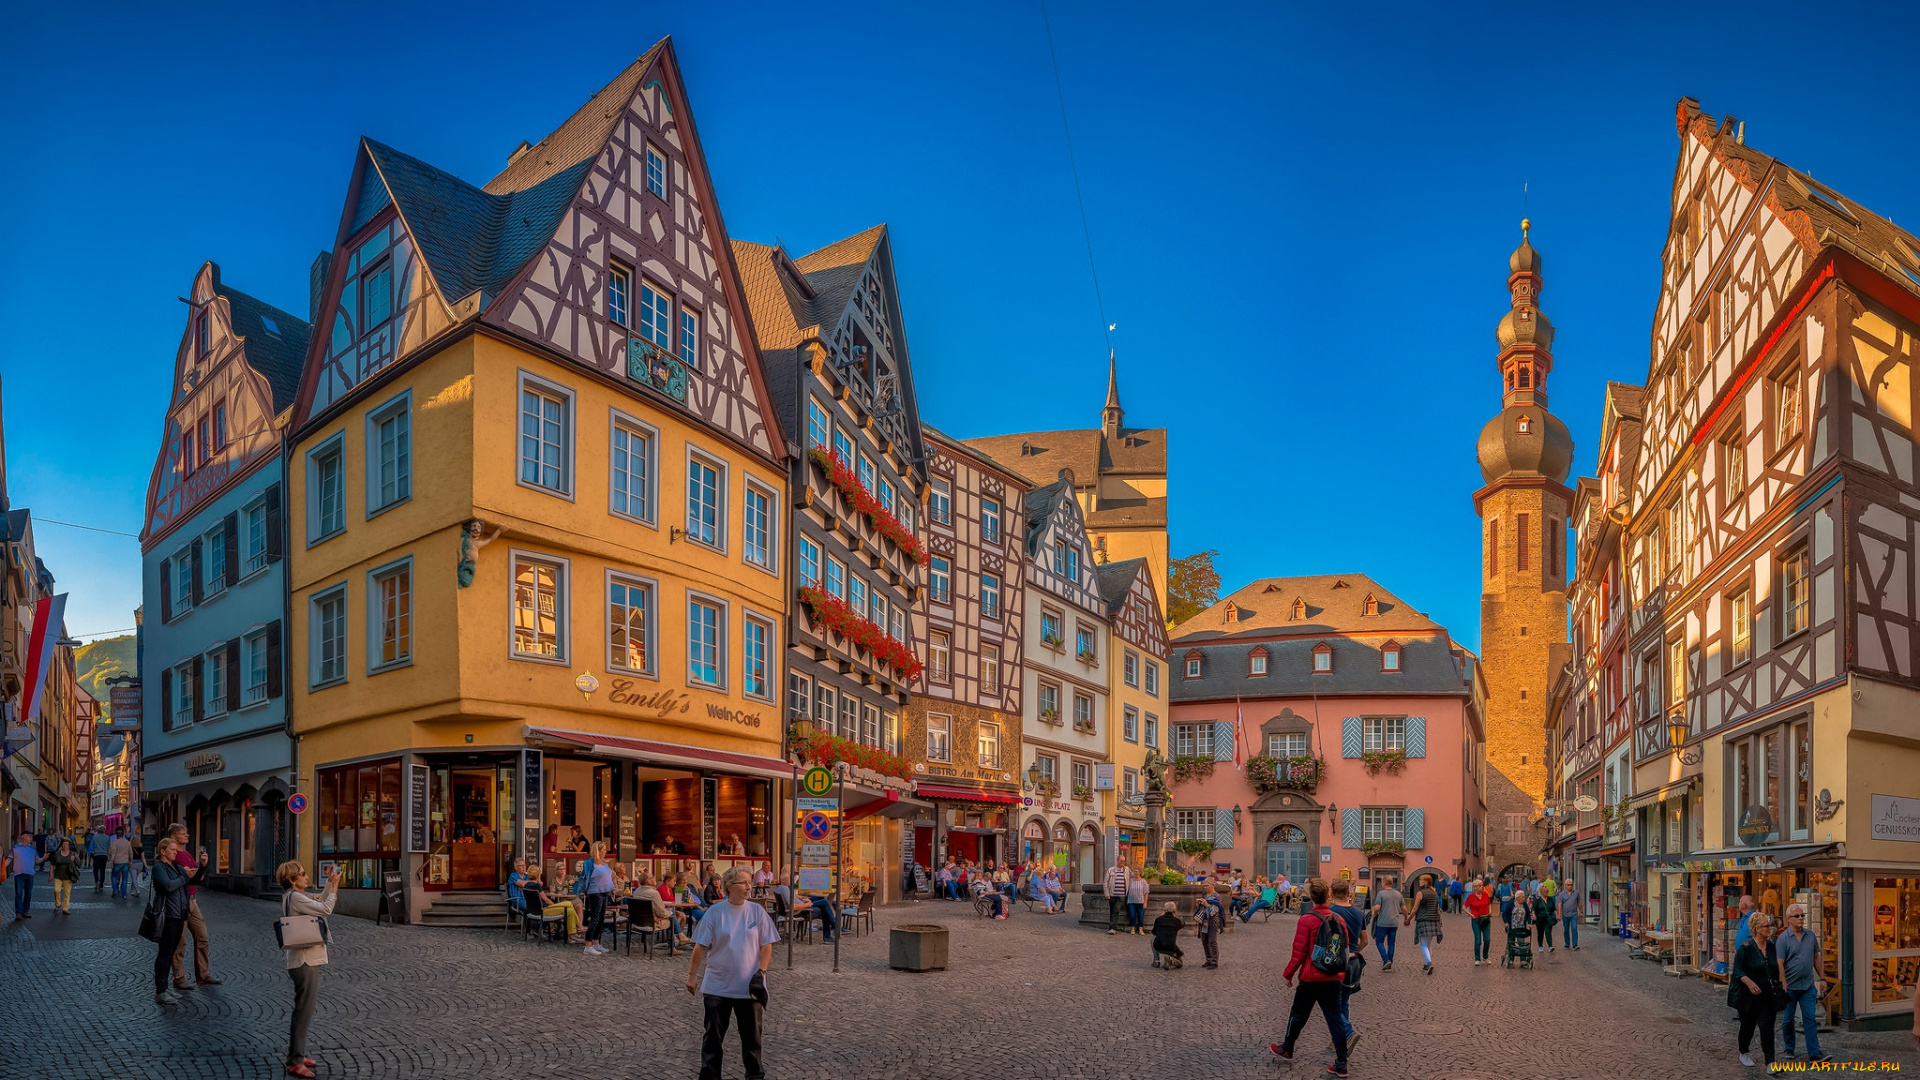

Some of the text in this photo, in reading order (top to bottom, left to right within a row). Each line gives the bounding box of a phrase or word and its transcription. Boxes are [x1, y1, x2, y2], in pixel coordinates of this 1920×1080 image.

[812, 773, 824, 789] H
[928, 766, 1000, 781] BISTRO Am Markt
[1034, 799, 1070, 811] UNSR PLATZ
